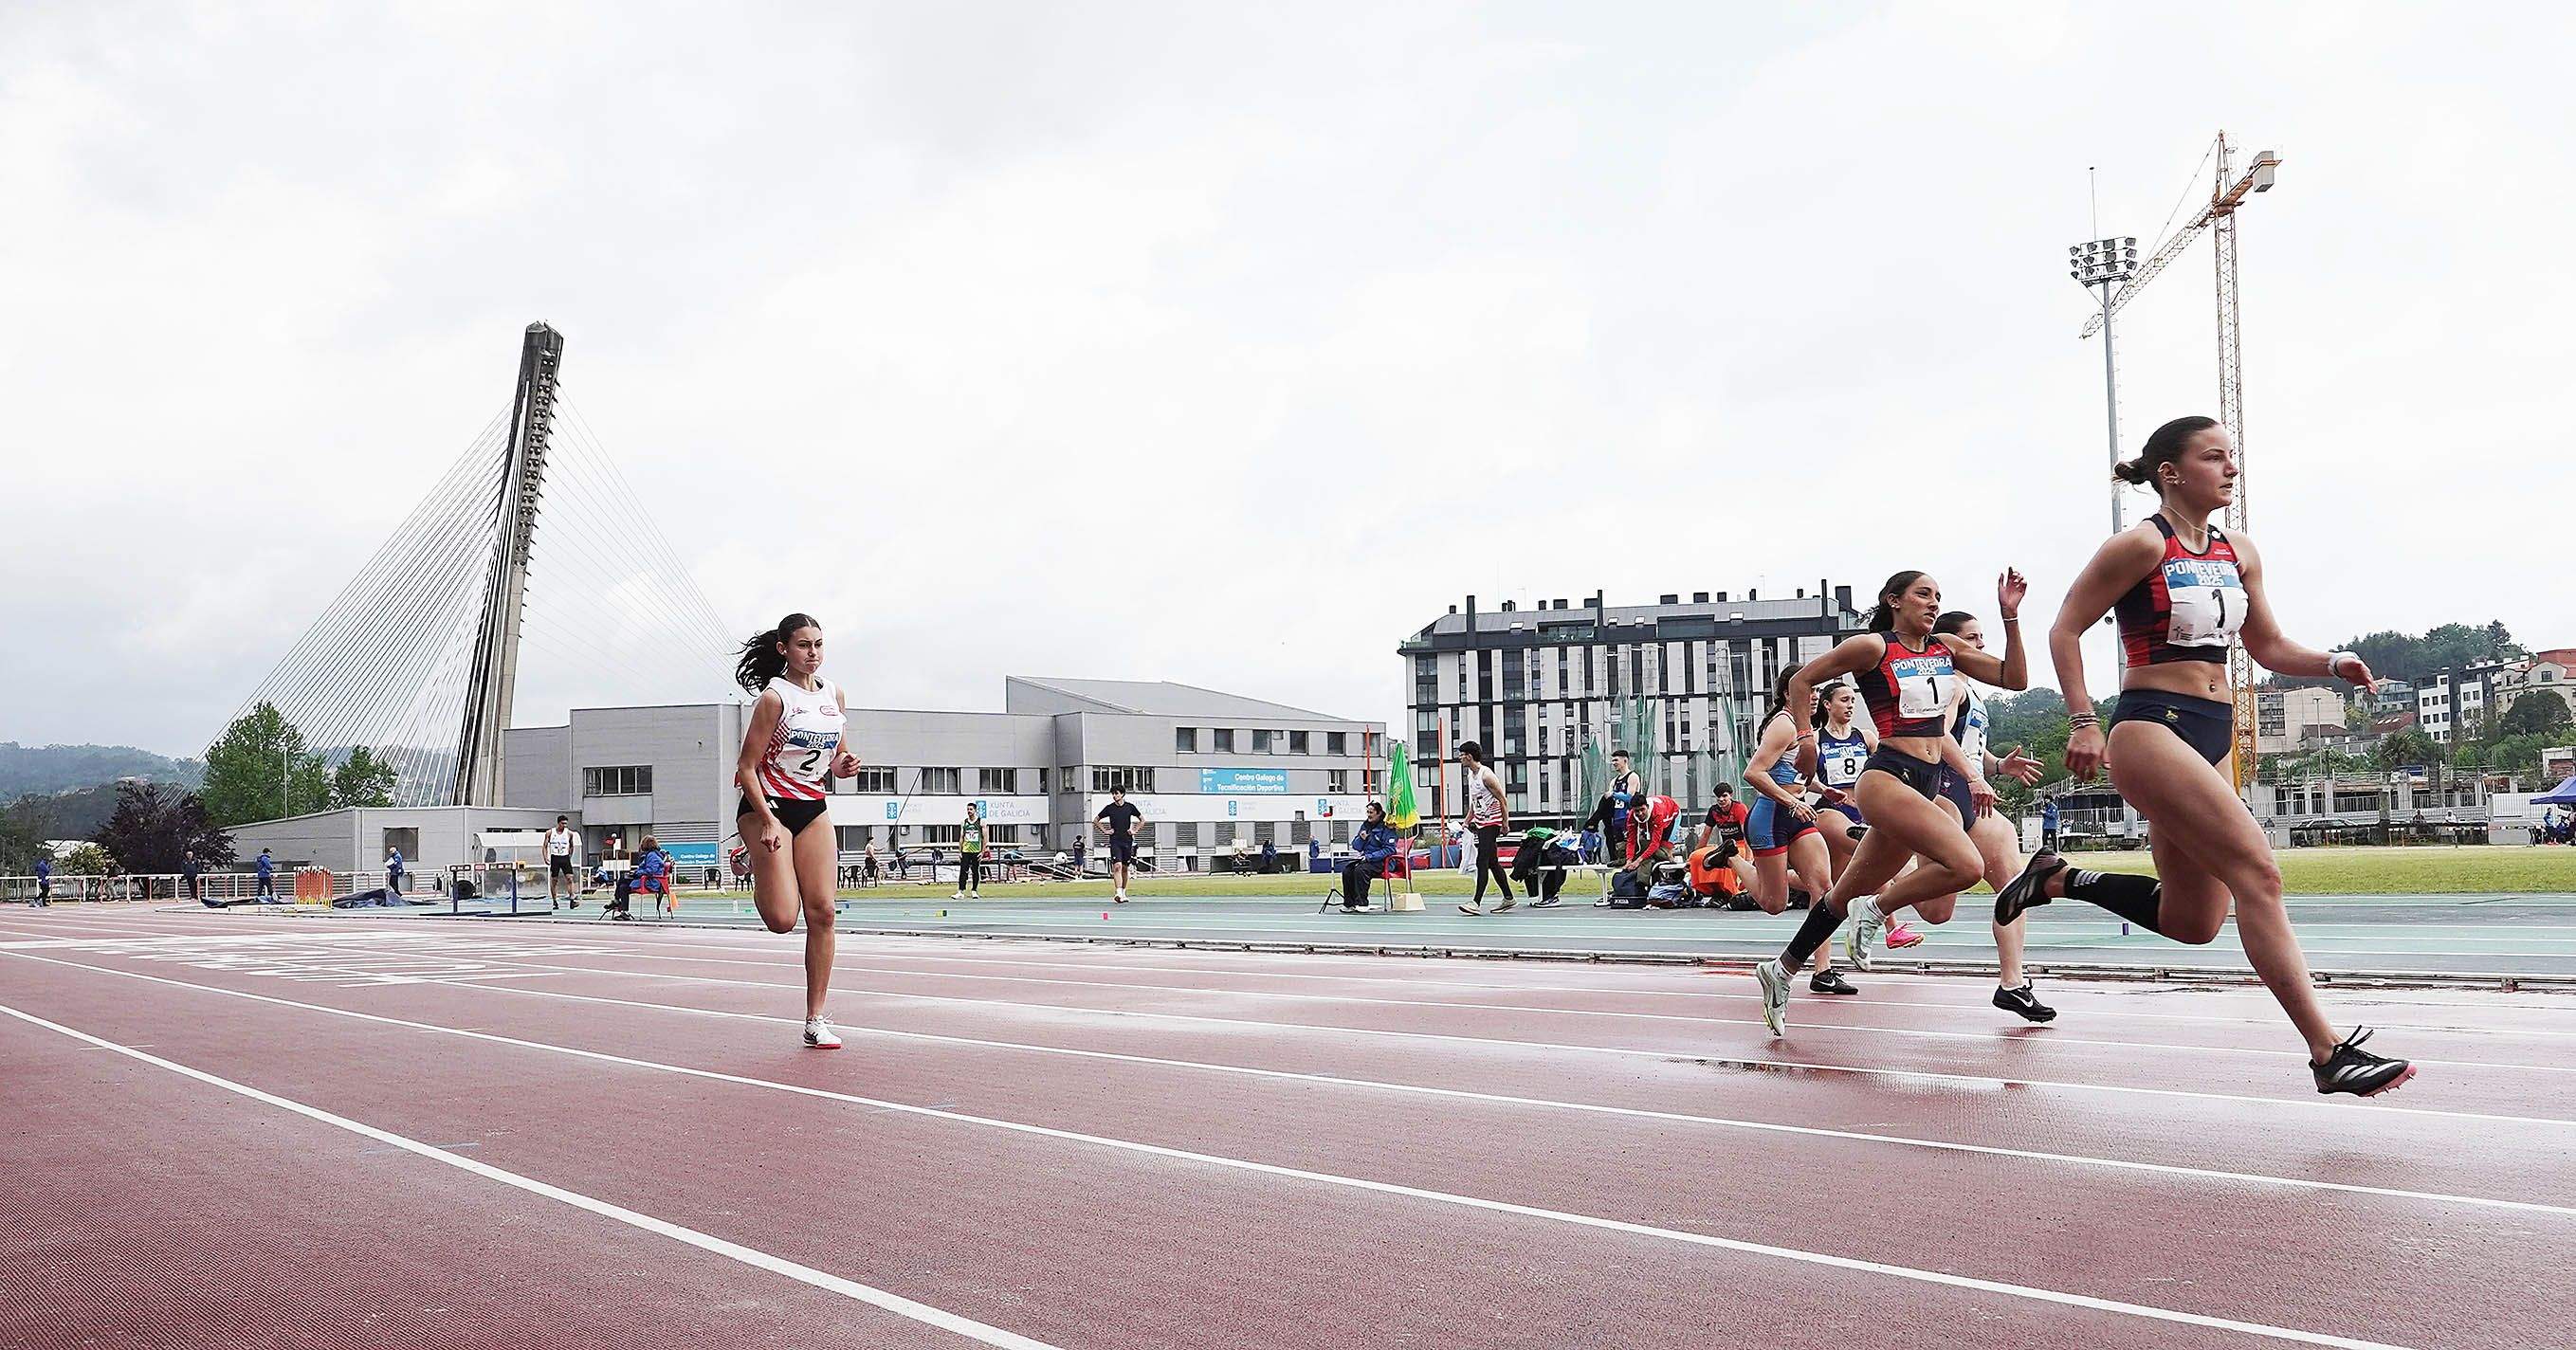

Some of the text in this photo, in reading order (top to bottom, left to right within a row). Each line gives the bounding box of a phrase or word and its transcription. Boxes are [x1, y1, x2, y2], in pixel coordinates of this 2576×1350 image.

[2212, 589, 2226, 629] 1
[1892, 657, 1952, 671] PONTEVEDRA
[1927, 677, 1939, 704] 1
[799, 750, 822, 772] 2
[1844, 758, 1856, 775] 8
[1234, 773, 1254, 782] Centro
[1255, 774, 1275, 782] Galego
[1000, 810, 1031, 818] GALICIA
